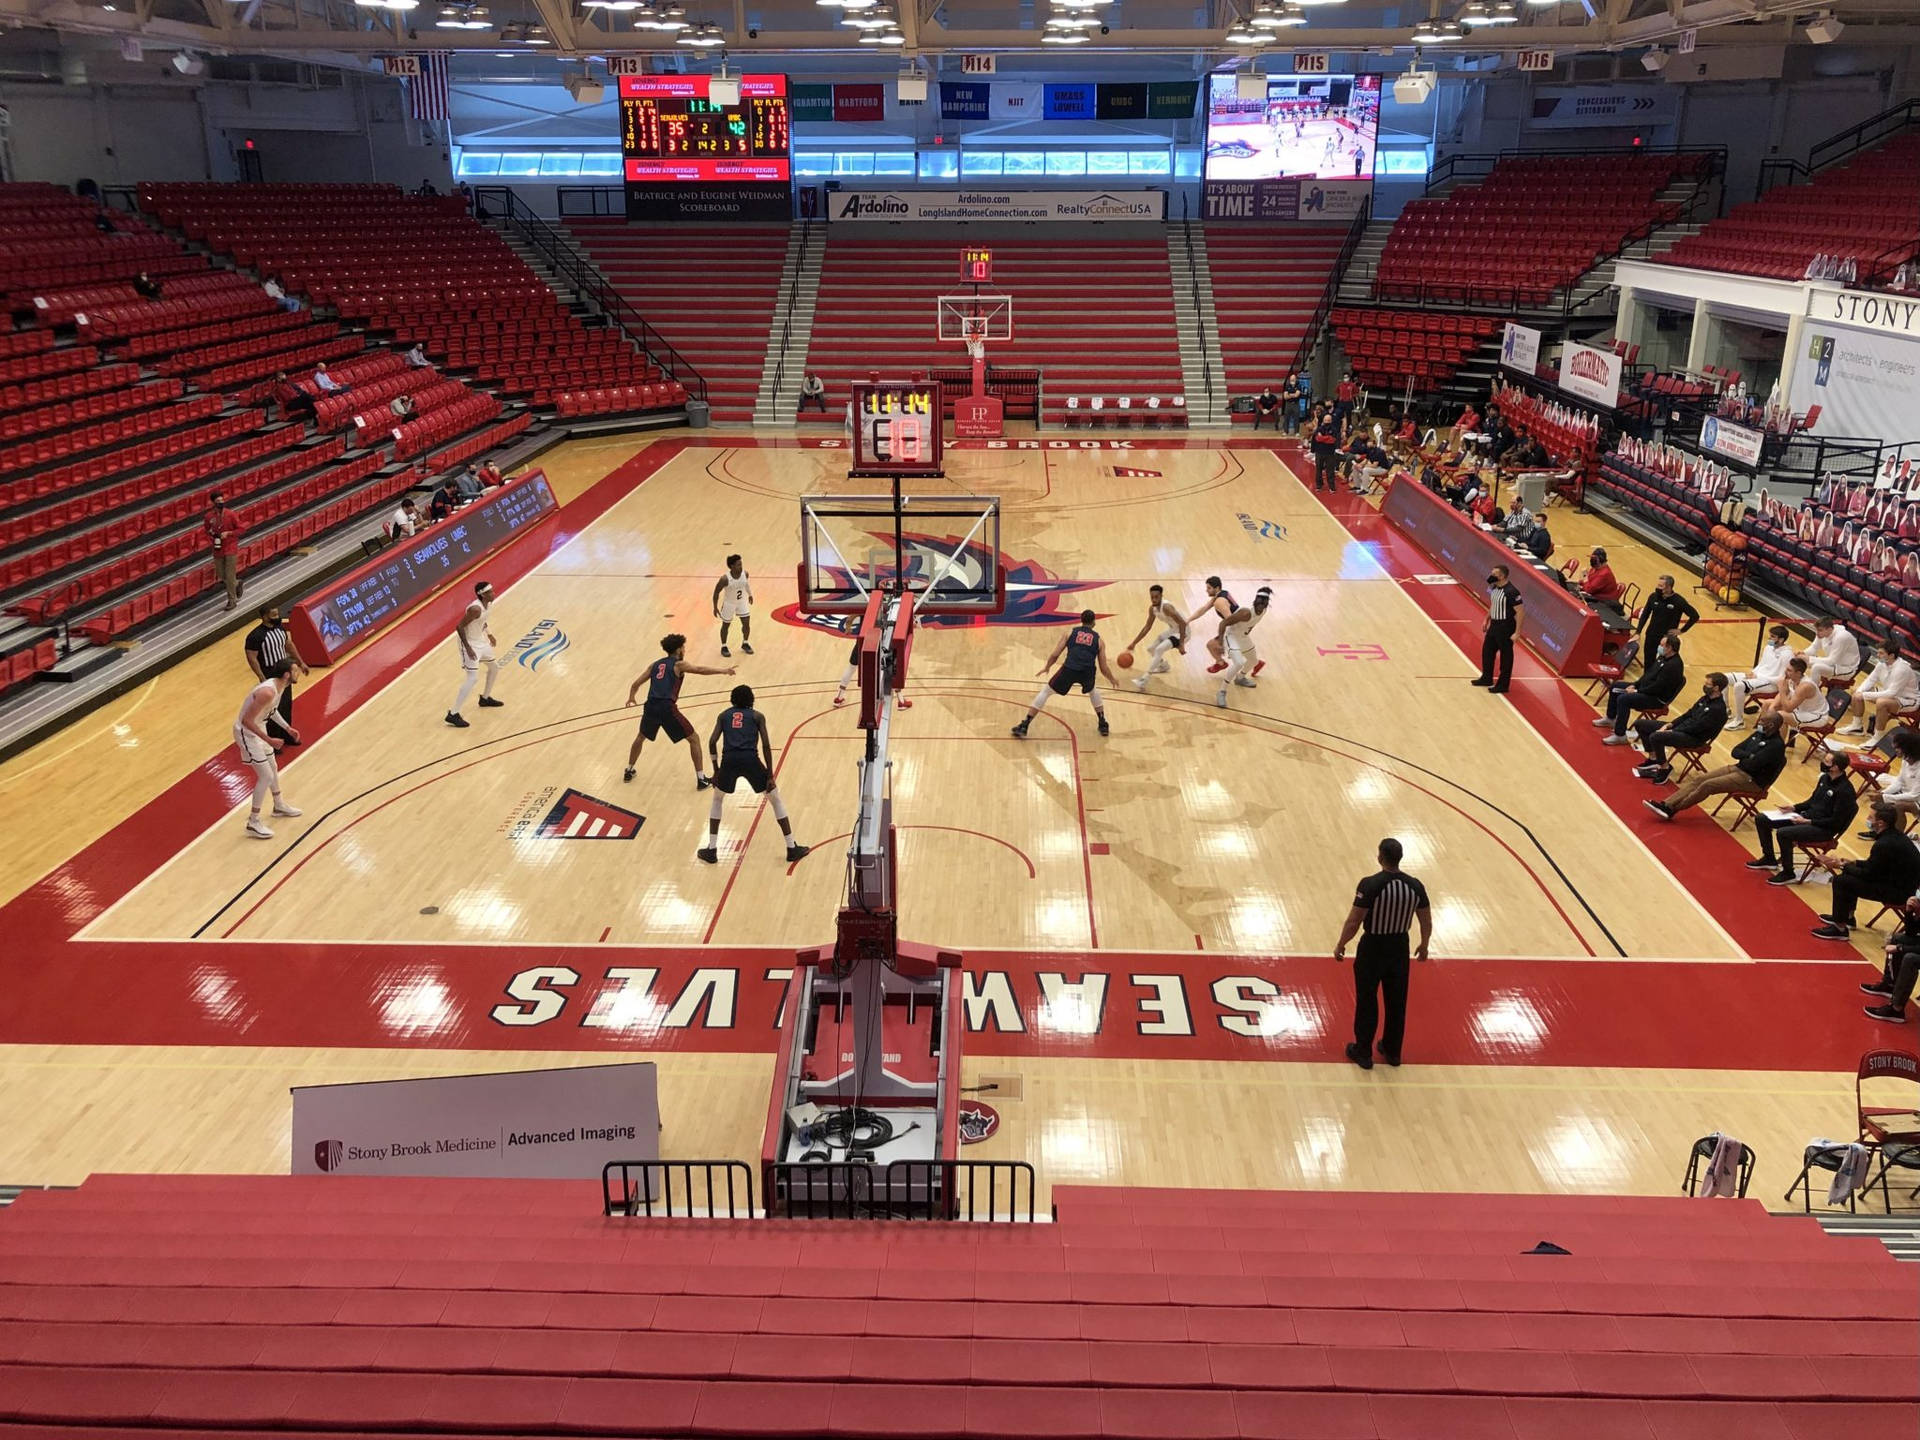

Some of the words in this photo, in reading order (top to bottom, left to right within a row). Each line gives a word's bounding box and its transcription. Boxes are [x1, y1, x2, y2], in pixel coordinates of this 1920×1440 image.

[394, 59, 416, 73] 112
[615, 58, 637, 73] 113
[970, 57, 991, 71] 114
[1304, 57, 1324, 70] 115
[1528, 54, 1549, 68] 116
[956, 90, 972, 99] NEW
[839, 98, 878, 107] HARTFORD
[942, 102, 986, 112] HAMPSHIRE
[668, 122, 684, 135] 35
[702, 123, 708, 134] 2
[729, 121, 746, 135] 42
[668, 140, 676, 151] 3
[682, 140, 689, 151] 2
[724, 139, 730, 151] 3
[738, 139, 746, 151] 5
[634, 191, 675, 200] BEATRICE
[677, 192, 698, 200] AND
[701, 191, 738, 200] EUGENE
[738, 191, 785, 200] WEIDMAN
[1207, 184, 1224, 194] IT'S
[1225, 184, 1254, 194] ABOUT
[839, 195, 909, 218] Ardolino
[958, 193, 1010, 206] Ardolino.com
[1207, 195, 1254, 217] TIME
[1262, 195, 1277, 207] 24
[679, 203, 740, 212] SCOREBOARD
[918, 206, 1048, 219] LongIslandHomeConnection.com
[1057, 202, 1151, 218] RealtyConnectUSA
[973, 262, 986, 277] 10
[1834, 294, 1918, 330] STONY
[871, 394, 929, 414] 11:14
[414, 537, 449, 565] SEAWOLVES
[450, 525, 467, 541] UMBC
[403, 558, 411, 569] 3
[736, 590, 743, 600] 2
[1075, 632, 1093, 646] 23
[656, 663, 668, 679] 3
[732, 711, 744, 729] 2
[1869, 1055, 1891, 1070] STONY
[1893, 1056, 1917, 1073] BROOK
[507, 1127, 576, 1147] Advanced
[579, 1124, 637, 1142] Imaging
[348, 1145, 388, 1162] Stony
[390, 1141, 433, 1158] Brook
[435, 1136, 498, 1153] Medicine
